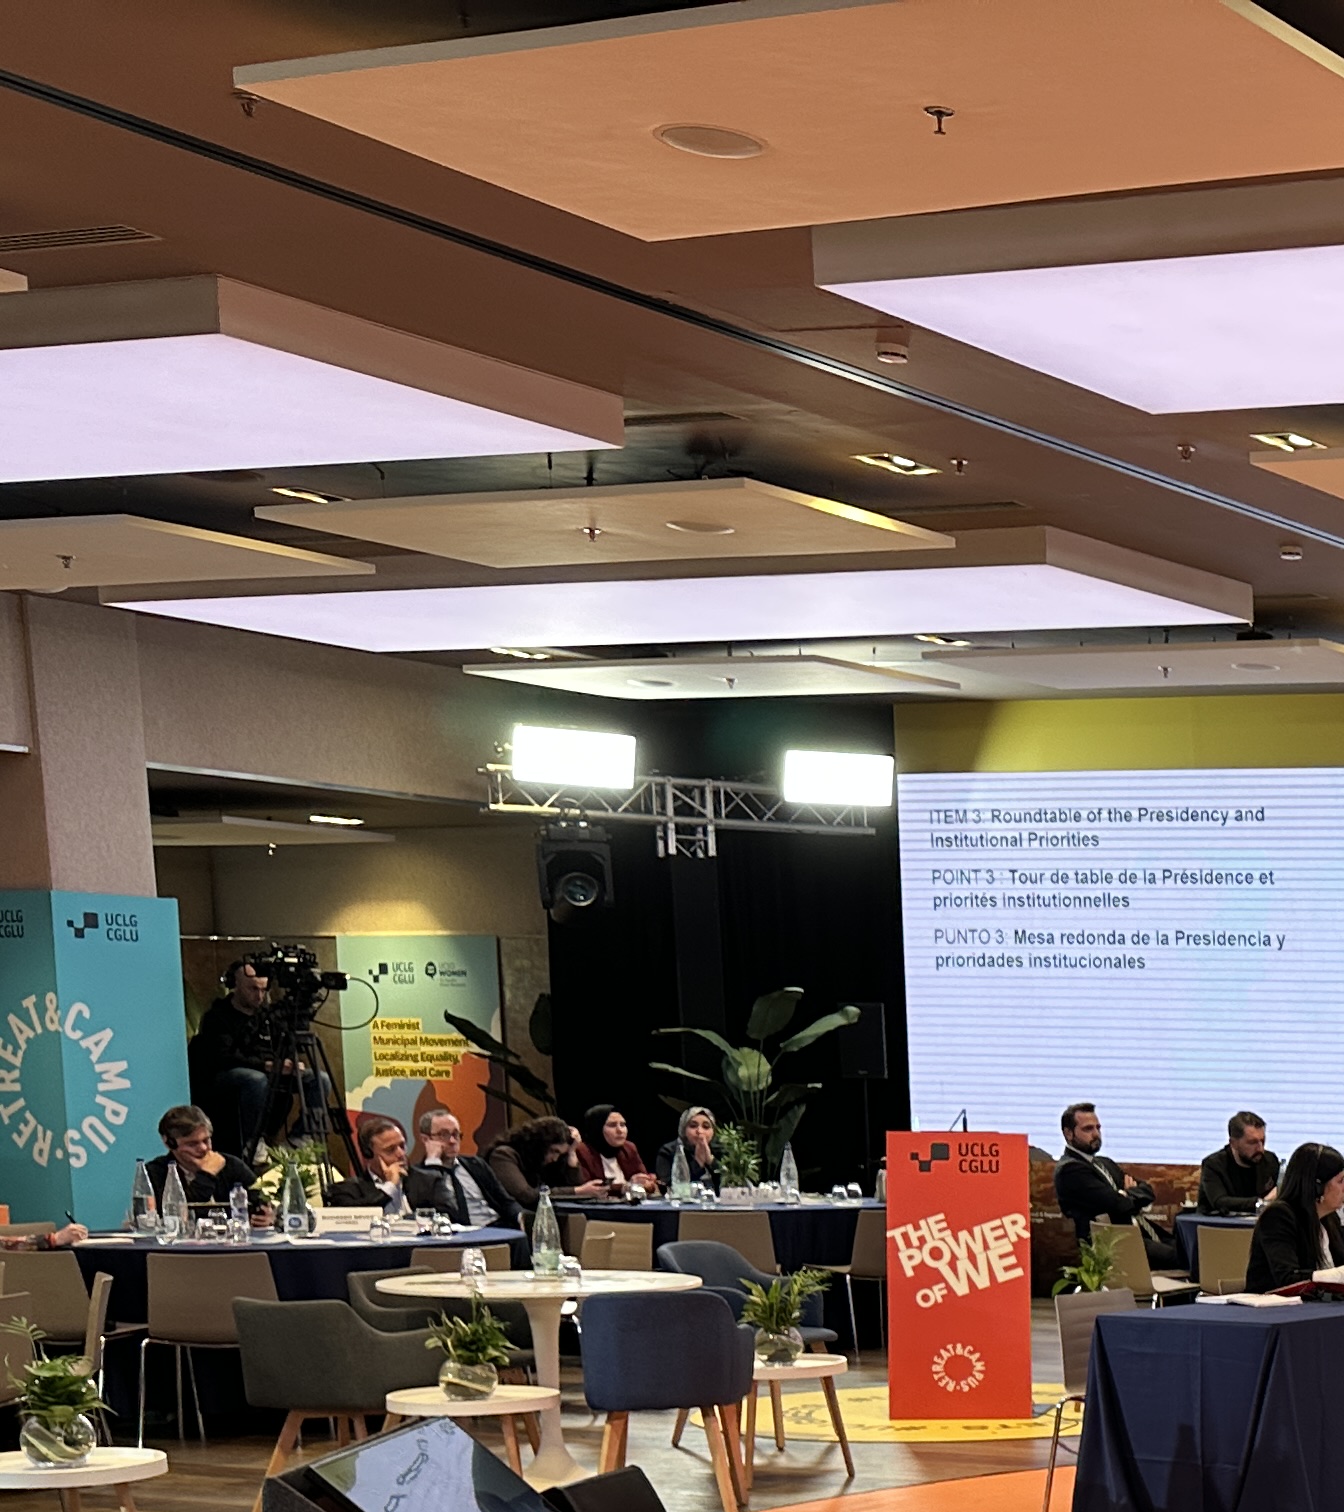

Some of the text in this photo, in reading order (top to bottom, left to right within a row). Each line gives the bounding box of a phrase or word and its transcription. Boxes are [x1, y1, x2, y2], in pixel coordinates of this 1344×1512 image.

[929, 809, 968, 824] ITEM
[991, 808, 1082, 824] Roundtable
[1086, 807, 1102, 823] of
[1107, 808, 1133, 823] the
[1138, 807, 1229, 826] Presidency
[1234, 807, 1265, 822] and
[931, 832, 1100, 848] Institutional Priorities
[932, 869, 981, 885] POINT
[986, 869, 995, 884] 3
[1008, 869, 1044, 884] Tour
[1050, 868, 1070, 884] de
[1074, 868, 1113, 884] table
[1118, 868, 1138, 884] de
[1142, 868, 1157, 884] la
[1162, 867, 1254, 885] Présidence
[1259, 869, 1275, 885] et
[933, 893, 1130, 911] priorités institutionnelles
[105, 913, 138, 928] UCLG
[106, 928, 139, 942] CGLU
[934, 929, 991, 945] PUNTO
[1014, 929, 1055, 945] Mesa
[1060, 929, 1126, 946] redonda
[1131, 929, 1151, 945] de
[1156, 929, 1169, 945] la
[1175, 930, 1272, 947] Presidencia
[1276, 934, 1286, 950] y
[935, 953, 1146, 970] prioridades institucionales
[373, 1020, 420, 1030] A Feminist
[410, 1068, 427, 1077] and
[428, 1069, 450, 1077] Care
[958, 1143, 1000, 1157] UCLG
[959, 1160, 1000, 1173] CGLU
[887, 1213, 951, 1250] THE
[898, 1213, 1031, 1278] POWER
[916, 1244, 1024, 1308] OF WE
